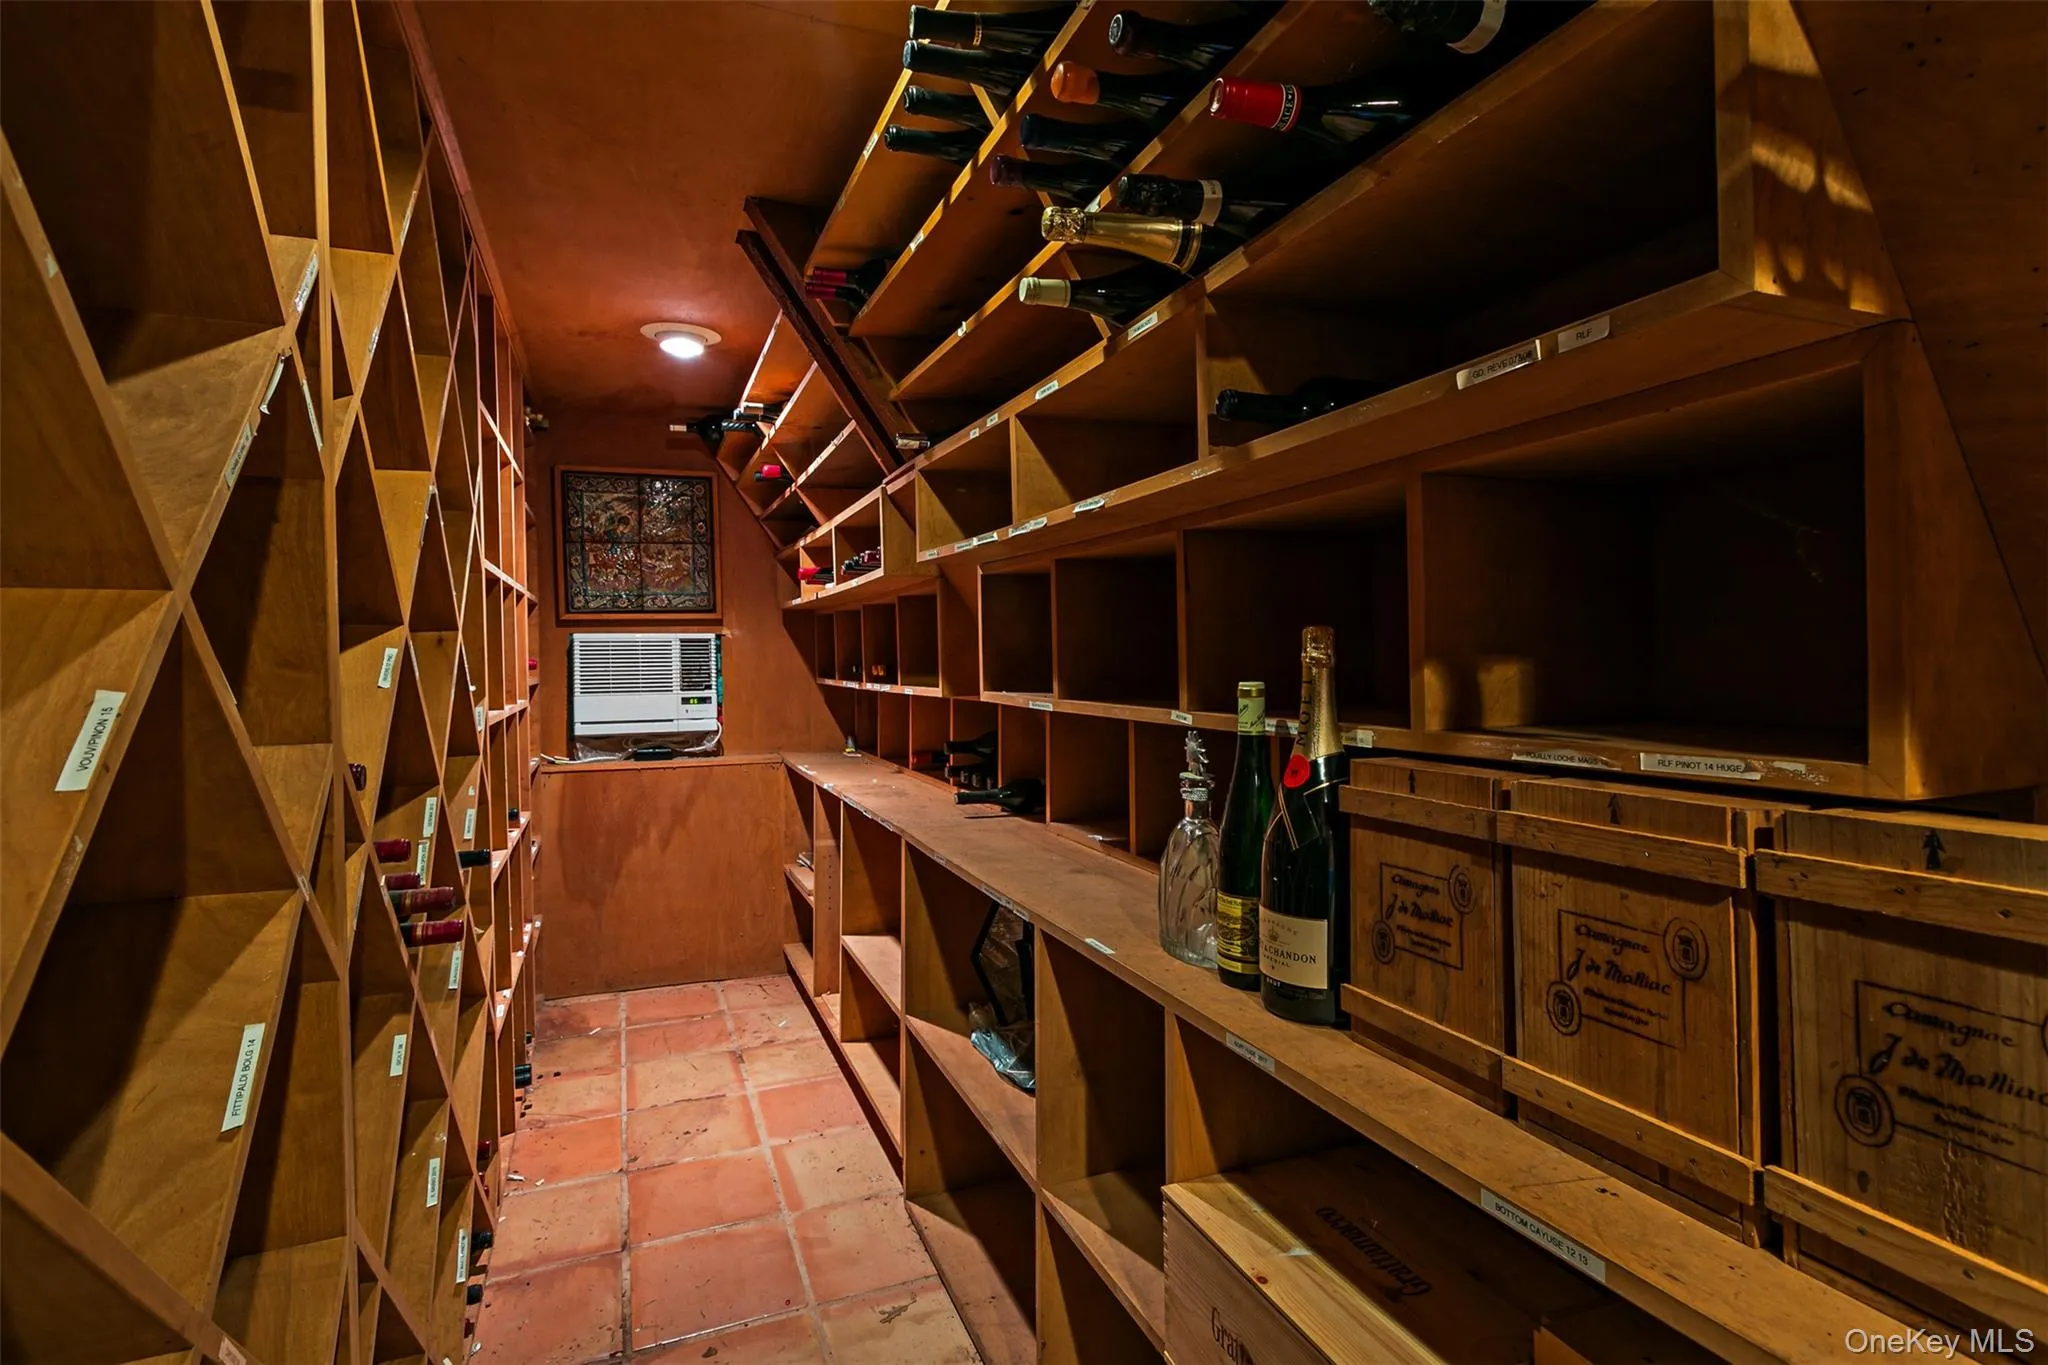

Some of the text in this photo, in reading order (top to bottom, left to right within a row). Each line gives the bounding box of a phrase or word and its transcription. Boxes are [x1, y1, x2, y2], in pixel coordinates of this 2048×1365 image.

[76, 706, 113, 772] VOUV/PINON 15
[1675, 760, 1702, 770] PINOT
[1716, 764, 1742, 773] HUGE
[1269, 946, 1317, 964] CHANDON
[231, 1038, 256, 1117] FITTIPALDI BOLG 14
[1495, 1201, 1589, 1266] BOTTOM CAYUSE 12 13
